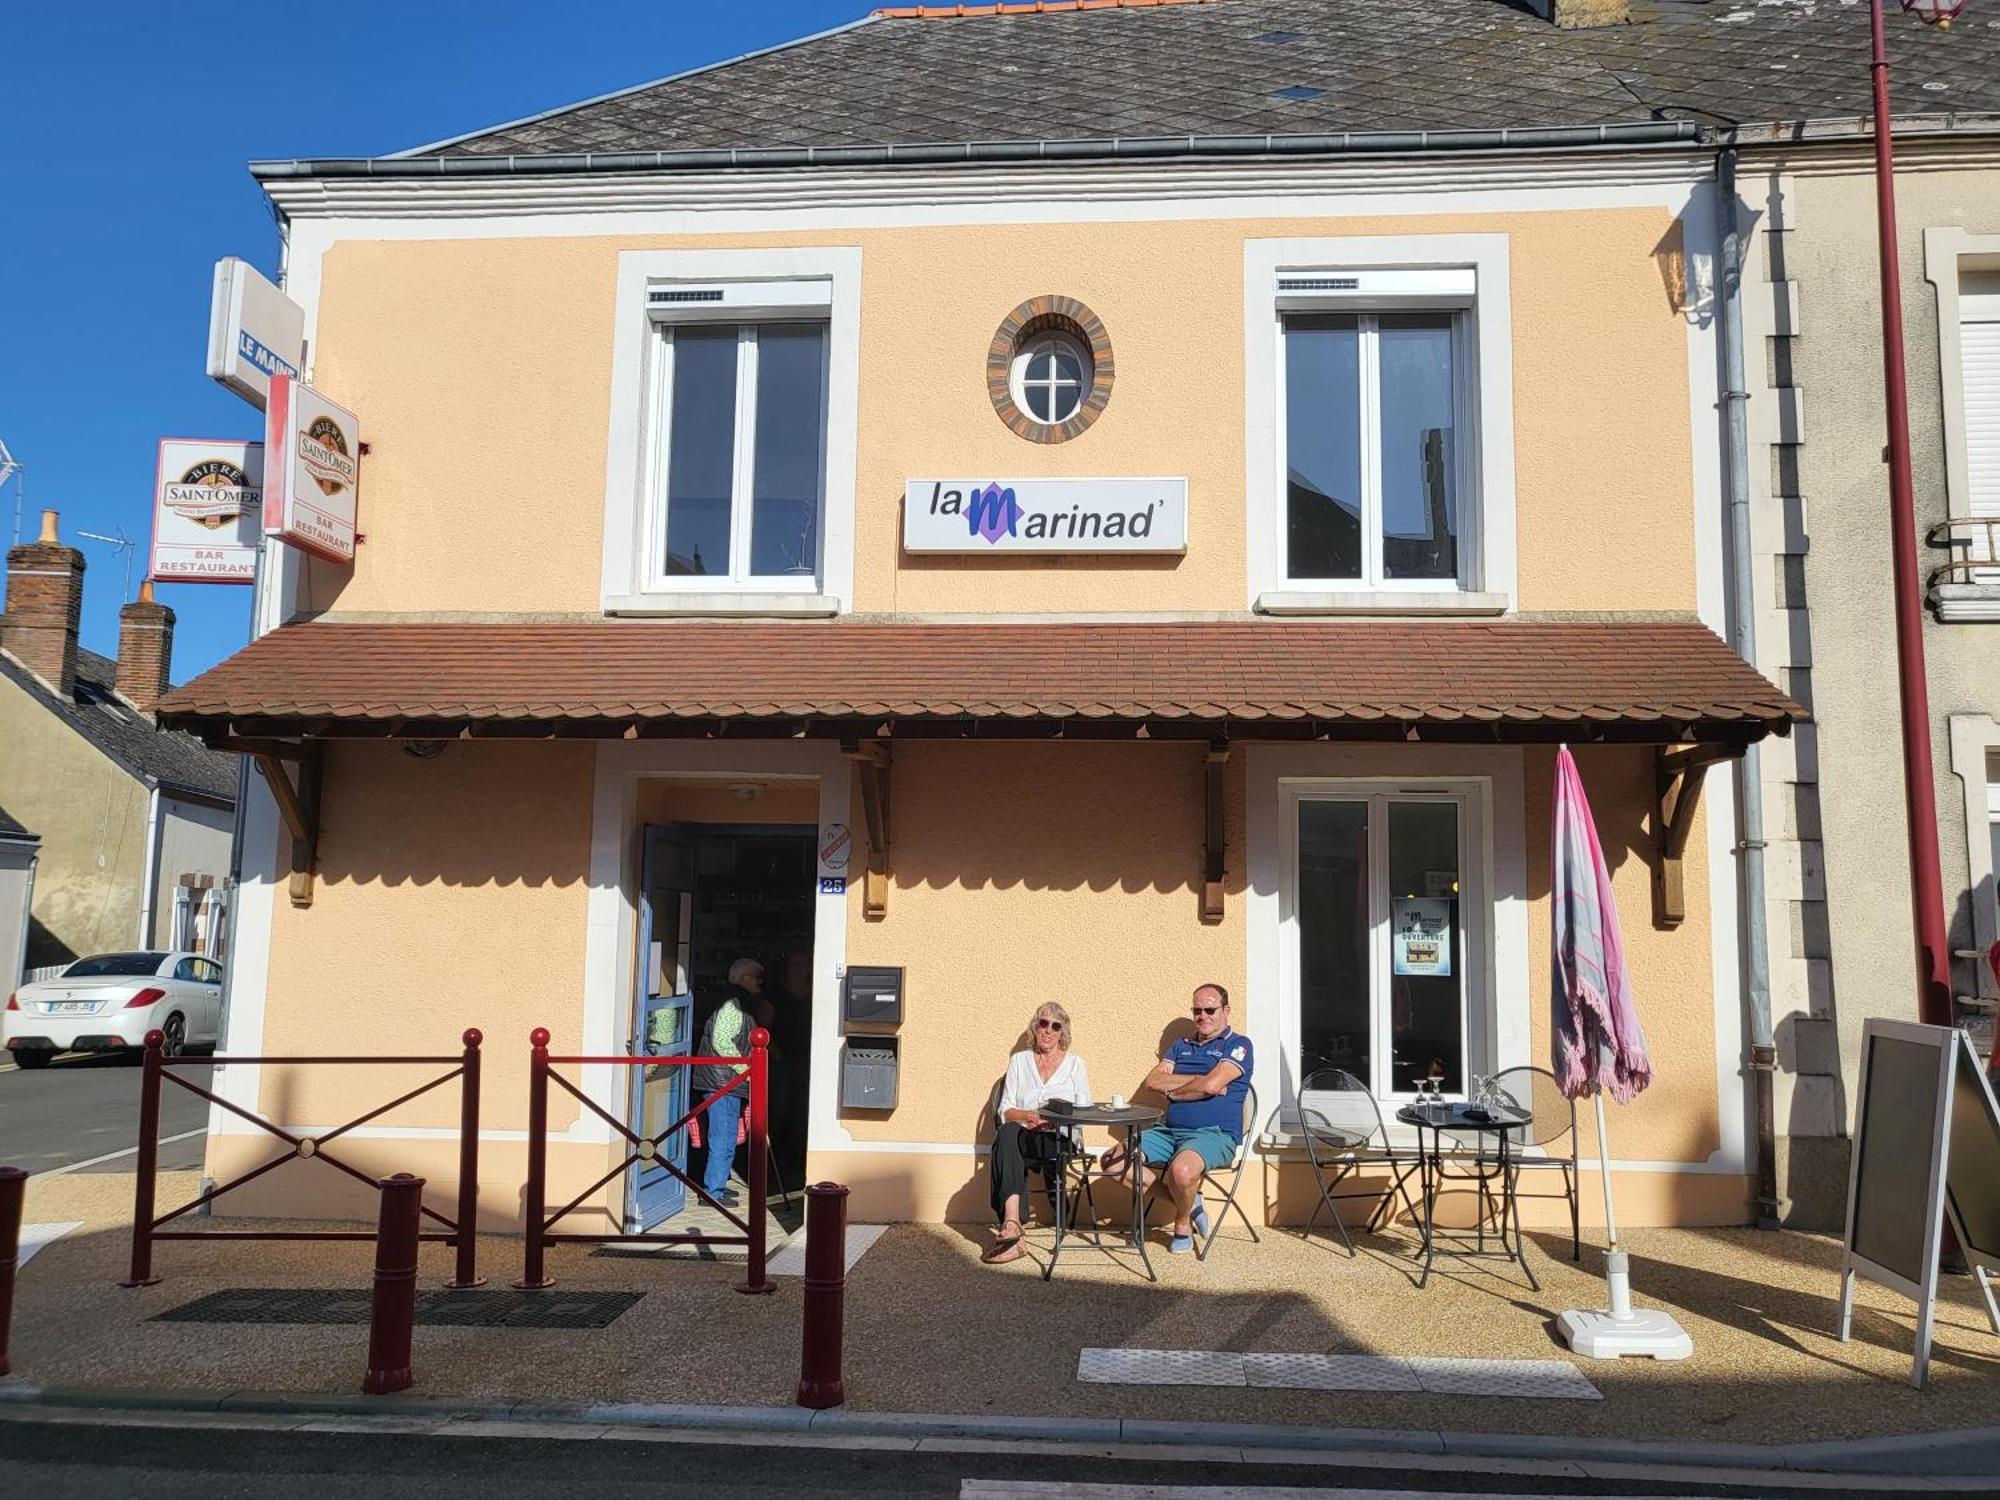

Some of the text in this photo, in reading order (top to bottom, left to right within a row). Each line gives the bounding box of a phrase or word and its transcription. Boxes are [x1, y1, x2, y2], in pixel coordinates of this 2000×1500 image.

[239, 332, 255, 357] LE
[930, 481, 963, 516] la
[316, 514, 333, 532] BAR
[294, 520, 350, 553] RESTAURANT
[194, 551, 225, 560] BAR
[160, 562, 255, 573] RESTAURANT
[823, 879, 842, 893] 25
